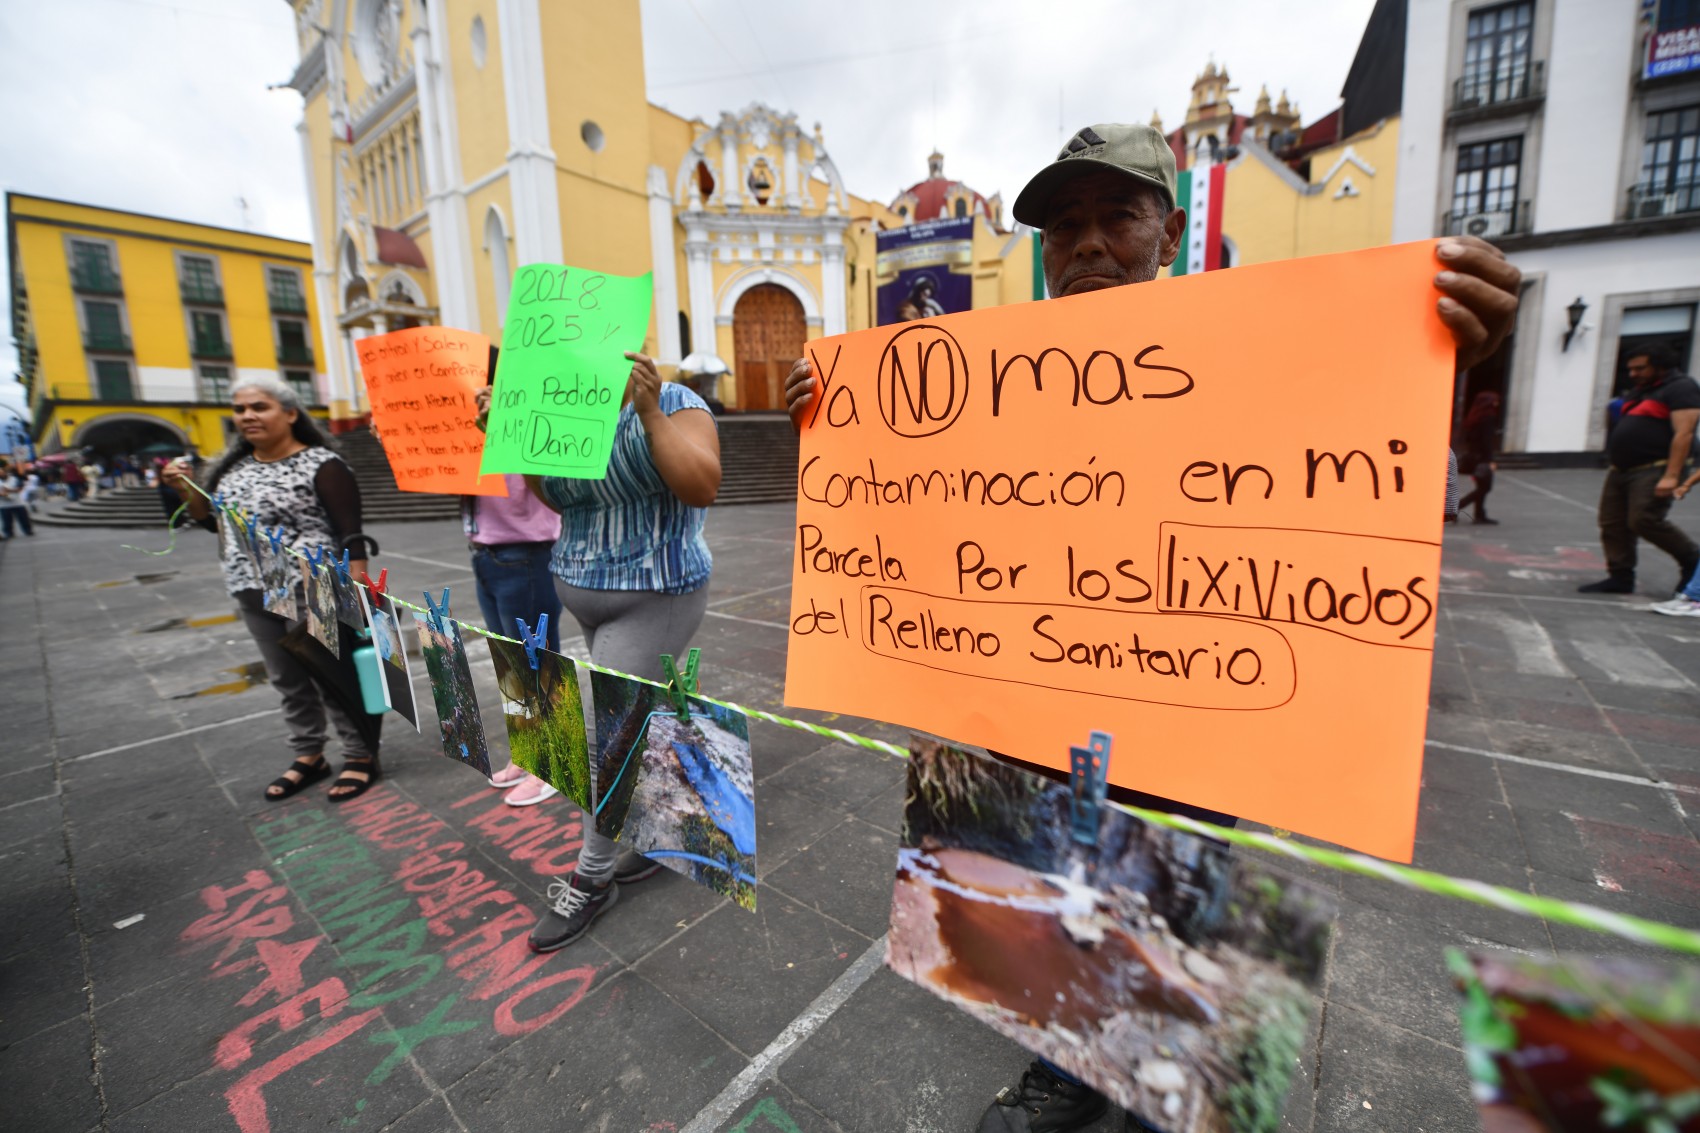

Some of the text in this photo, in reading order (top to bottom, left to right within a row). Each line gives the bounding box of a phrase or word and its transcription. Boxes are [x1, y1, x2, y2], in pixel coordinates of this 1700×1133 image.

[422, 334, 470, 353] Salen
[505, 313, 583, 351] 2025
[497, 379, 527, 409] han
[808, 338, 1195, 430] Ya NO mas
[502, 417, 524, 445] Mi
[530, 415, 594, 458] Daño
[800, 439, 1408, 509] Contaminación en mi
[798, 524, 907, 583] Parcela
[955, 540, 1027, 595] Por
[1067, 545, 1152, 604] los
[792, 598, 849, 639] del
[868, 593, 1001, 658] Relleno
[176, 868, 384, 1133] ISRAEL
